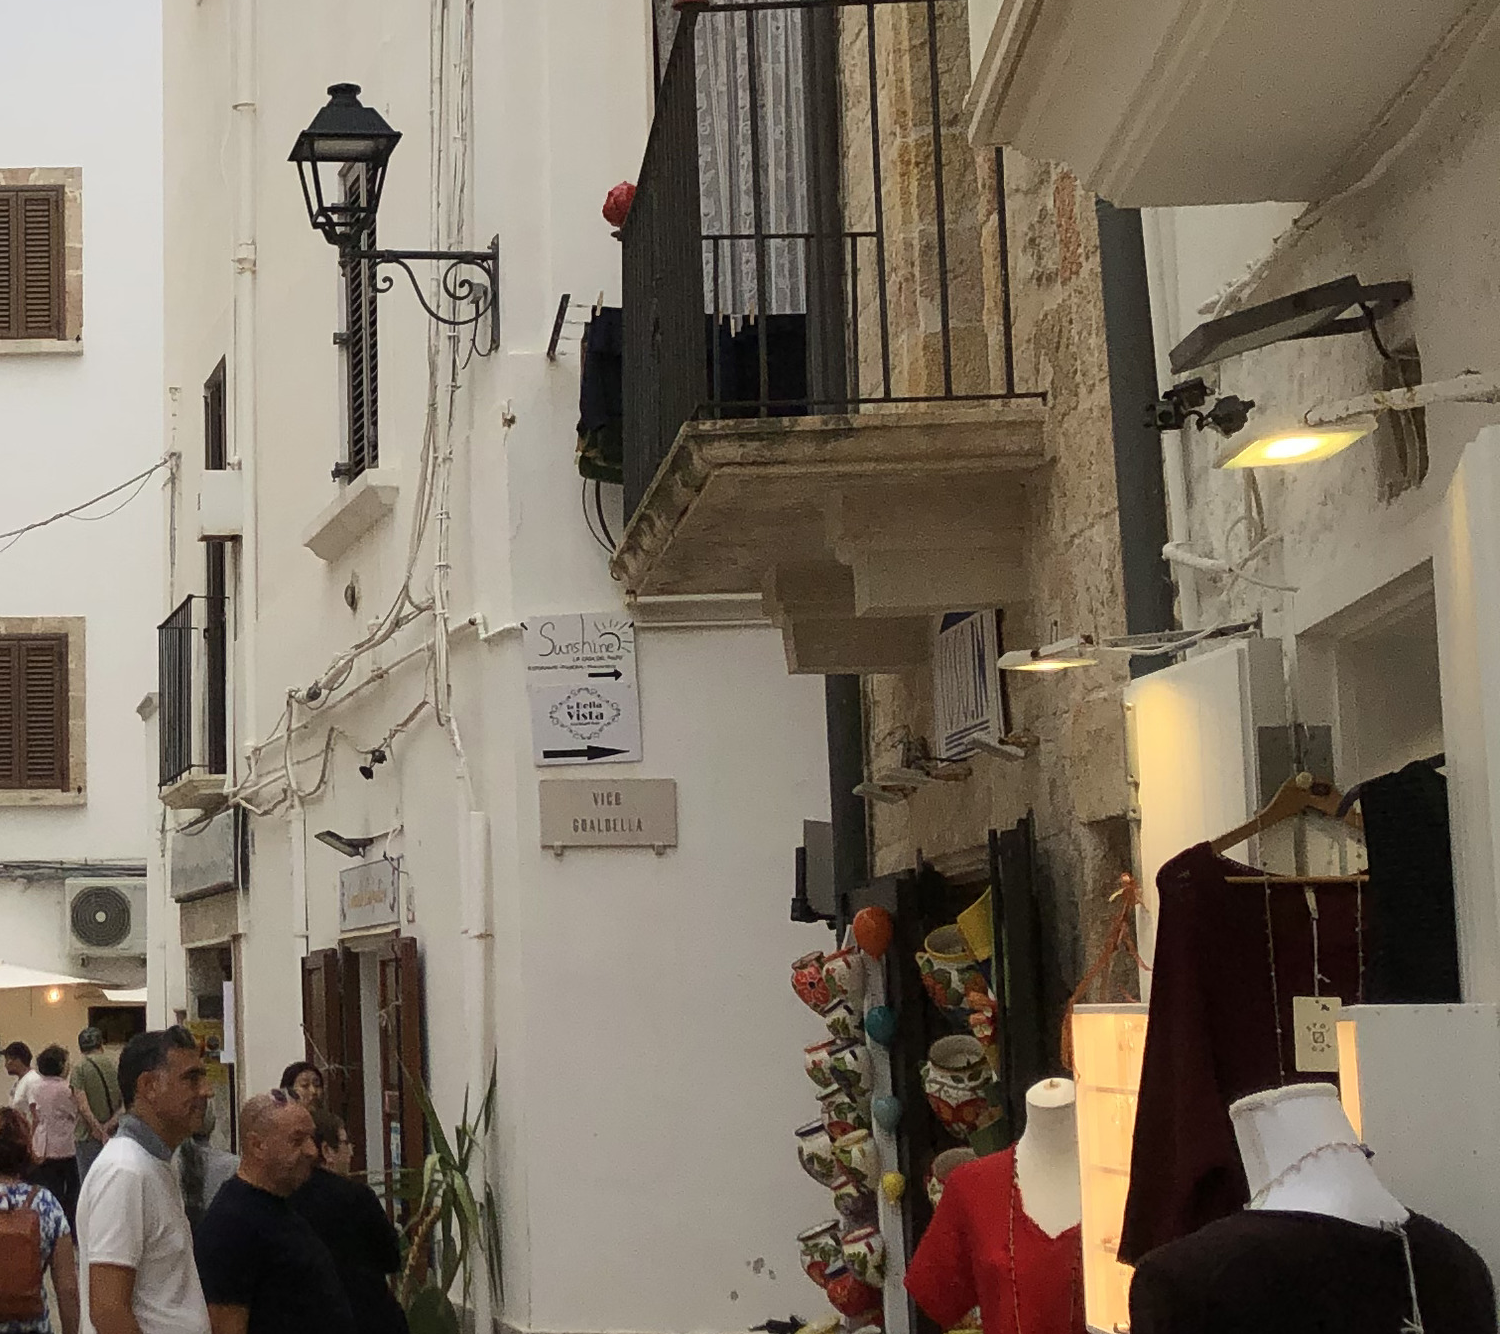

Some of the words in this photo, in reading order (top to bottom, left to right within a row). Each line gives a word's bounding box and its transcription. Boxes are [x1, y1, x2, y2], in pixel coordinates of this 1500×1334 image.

[539, 614, 614, 657] Sunshine
[567, 710, 604, 721] Vista
[592, 791, 622, 806] VICO
